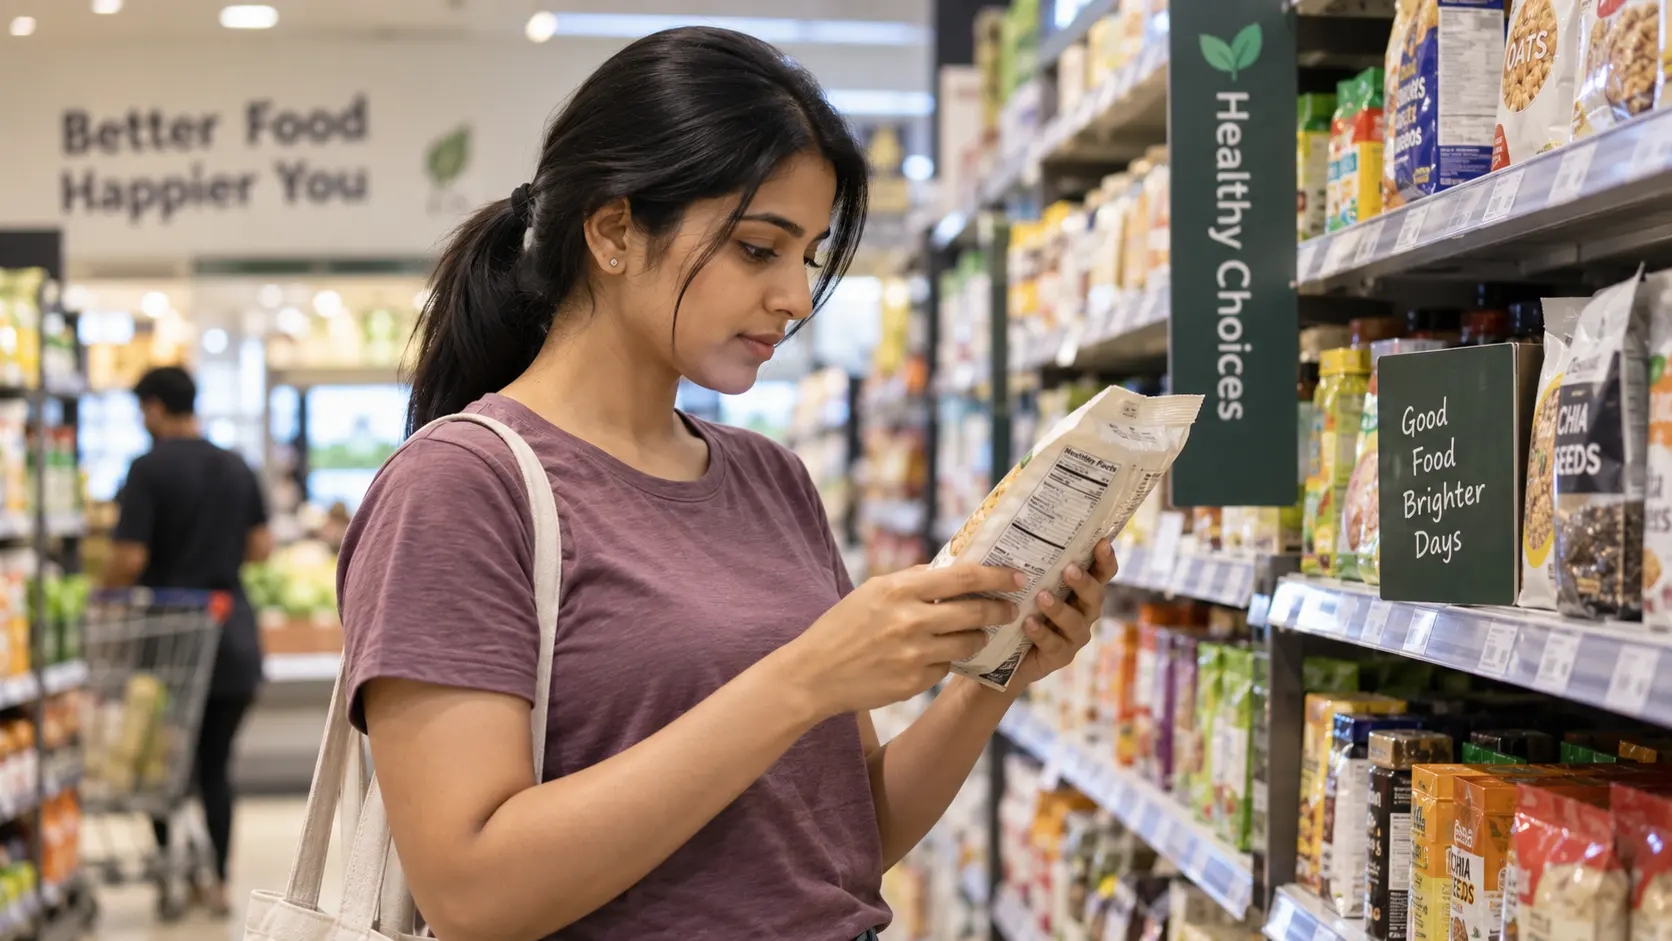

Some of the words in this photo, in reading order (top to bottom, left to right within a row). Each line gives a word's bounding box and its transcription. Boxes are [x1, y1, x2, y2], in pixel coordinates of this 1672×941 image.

[1506, 30, 1548, 72] OATS
[61, 108, 218, 156] Better
[245, 93, 368, 145] Food
[1208, 91, 1251, 249] Healthy
[61, 164, 254, 223] Happier
[276, 162, 367, 204] You
[1216, 260, 1252, 421] Choices
[1401, 396, 1448, 438] Good
[1557, 402, 1589, 436] CHIA
[1412, 437, 1456, 476] Food
[1403, 481, 1485, 523] Brighter
[1414, 530, 1461, 563] Days
[1452, 877, 1475, 905] EEDS
